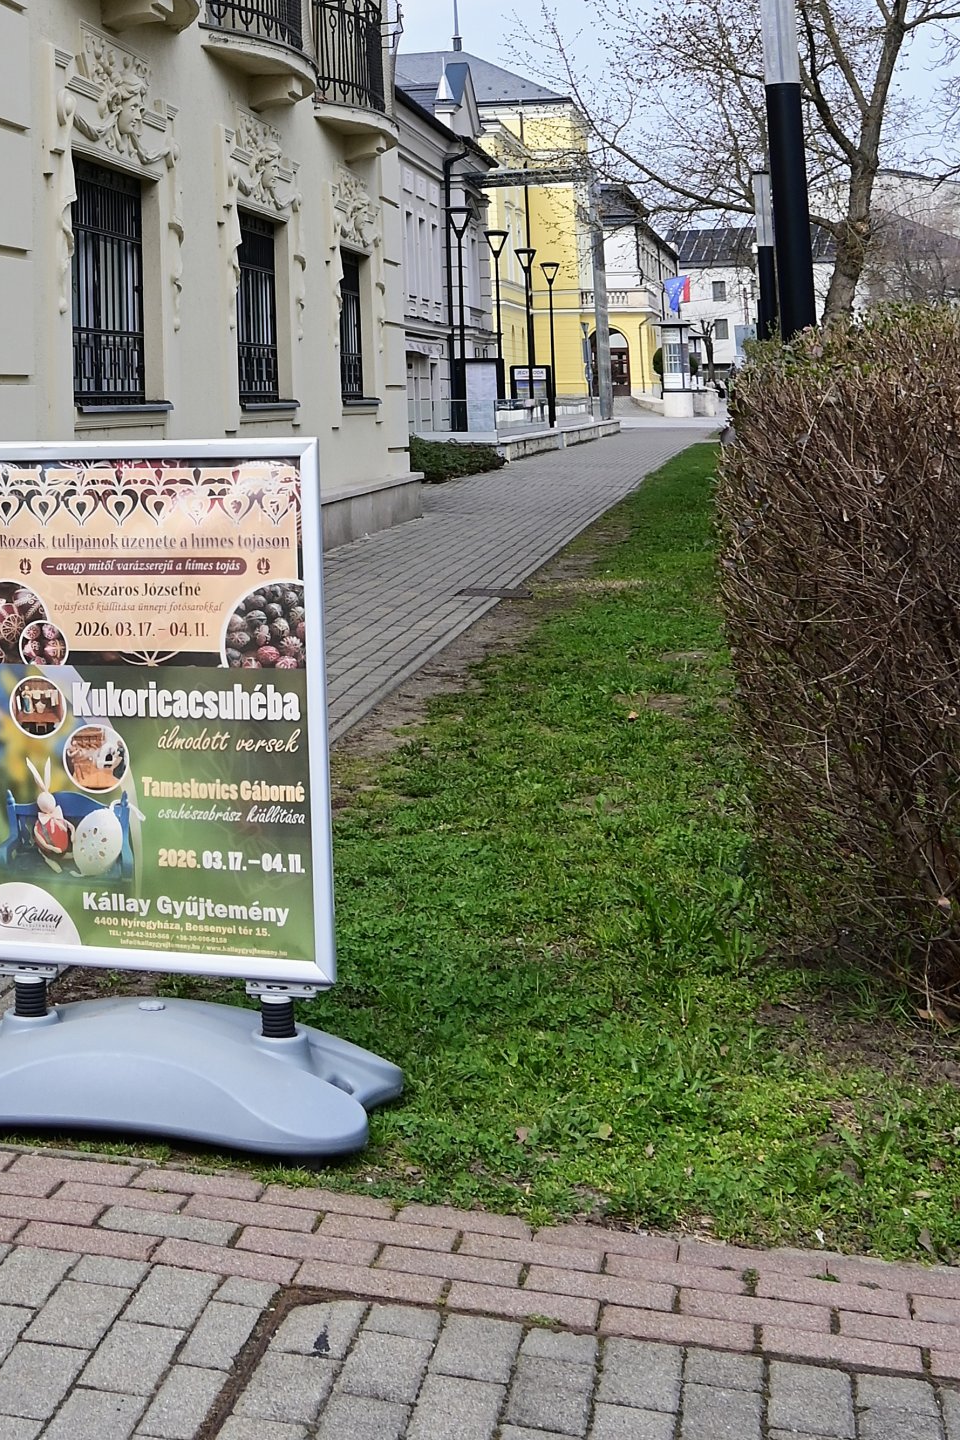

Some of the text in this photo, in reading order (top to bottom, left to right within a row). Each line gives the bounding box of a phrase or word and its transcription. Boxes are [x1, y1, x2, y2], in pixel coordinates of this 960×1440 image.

[52, 534, 119, 553] tulipánok
[121, 535, 176, 548] üzenete
[180, 538, 187, 548] a
[191, 533, 234, 548] hímes
[238, 534, 290, 552] tojáson
[56, 563, 86, 574] avagy
[88, 560, 114, 571] mitől
[116, 560, 173, 574] varázserejű
[185, 559, 214, 571] hímes
[216, 560, 240, 574] tojás
[77, 581, 201, 596] Mészáros Józsefné
[54, 601, 223, 614] tojásfestő kiállítása ünnepi fotósarokkal
[72, 681, 301, 722] Kukoricacsuhéba
[158, 725, 301, 753] álmodott versek
[141, 776, 305, 803] Tamaskovics Gáborné
[158, 804, 305, 824] csuhészobrász kiállítása
[14, 905, 62, 929] Kállay
[82, 891, 290, 927] Kállay Gyűjtemény
[94, 916, 270, 937] 4400 Nyíregyháza, Bessenyei tér 15.
